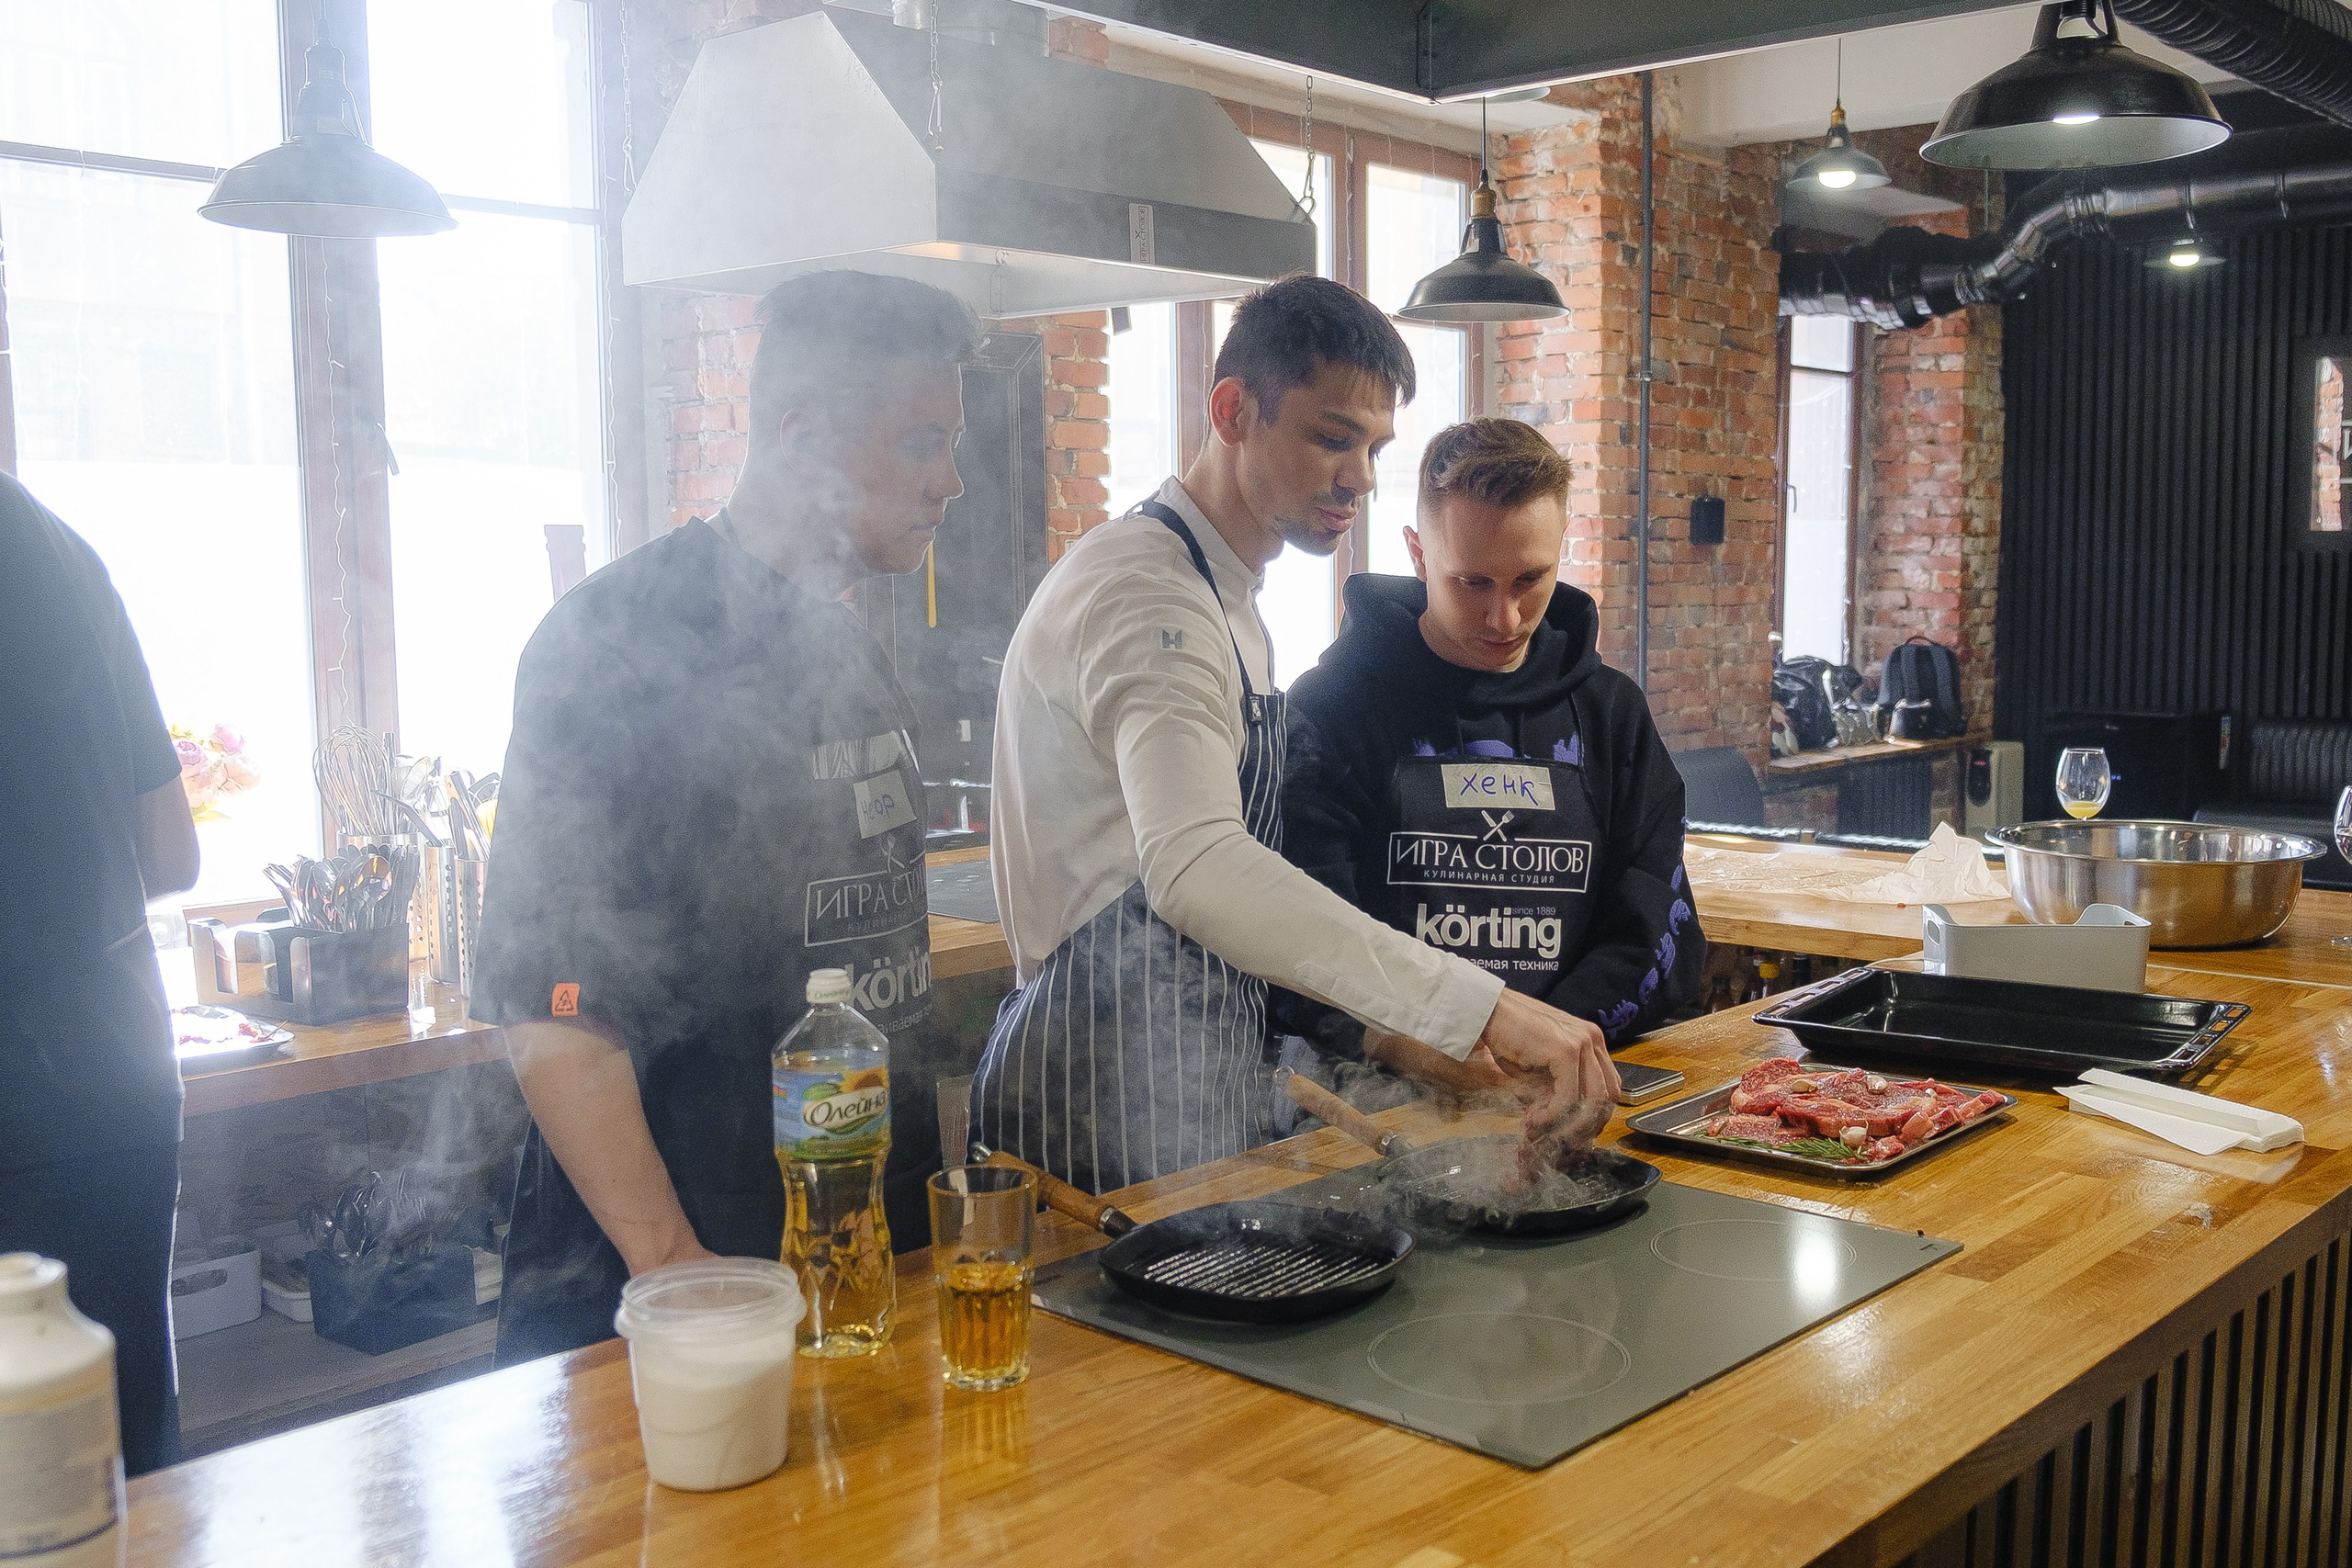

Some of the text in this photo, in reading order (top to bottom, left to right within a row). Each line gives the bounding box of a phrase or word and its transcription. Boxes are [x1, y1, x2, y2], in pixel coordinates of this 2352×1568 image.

[1396, 839, 1585, 874] ИГРА СТОЛОВ
[1423, 869, 1555, 885] КУЛИНАРНАЯ СТУДИЯ
[816, 881, 889, 919] ИГРА
[1511, 907, 1556, 916] since 1889
[1416, 903, 1562, 959] körting
[1512, 960, 1560, 972] техника
